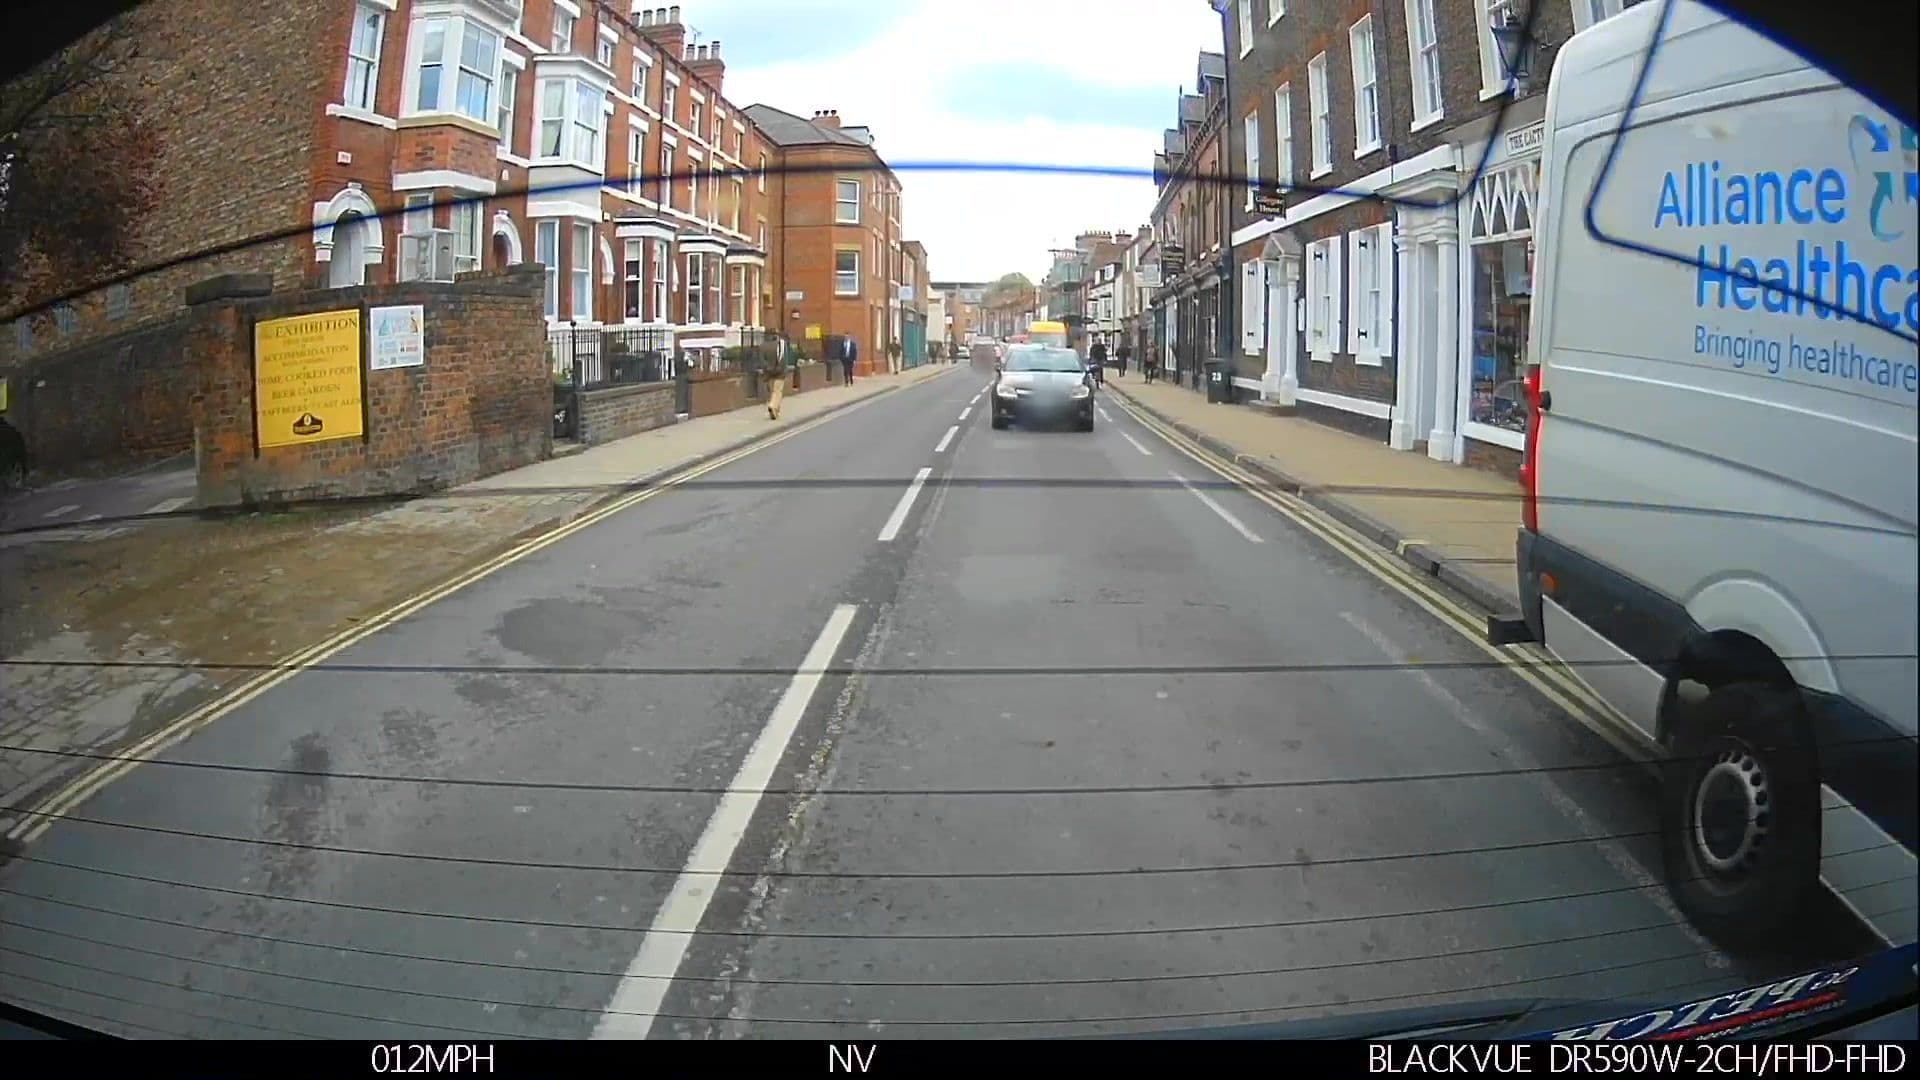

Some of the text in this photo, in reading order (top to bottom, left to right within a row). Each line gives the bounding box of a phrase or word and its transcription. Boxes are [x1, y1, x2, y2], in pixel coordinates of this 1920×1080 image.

[1655, 160, 1847, 229] Alliance
[274, 317, 358, 336] EXHIBITION
[263, 344, 349, 362] ACCOMMODATION
[1693, 324, 1917, 393] Bringing healthcare
[285, 369, 327, 381] COOKED
[271, 383, 342, 400] BEER GARDEN
